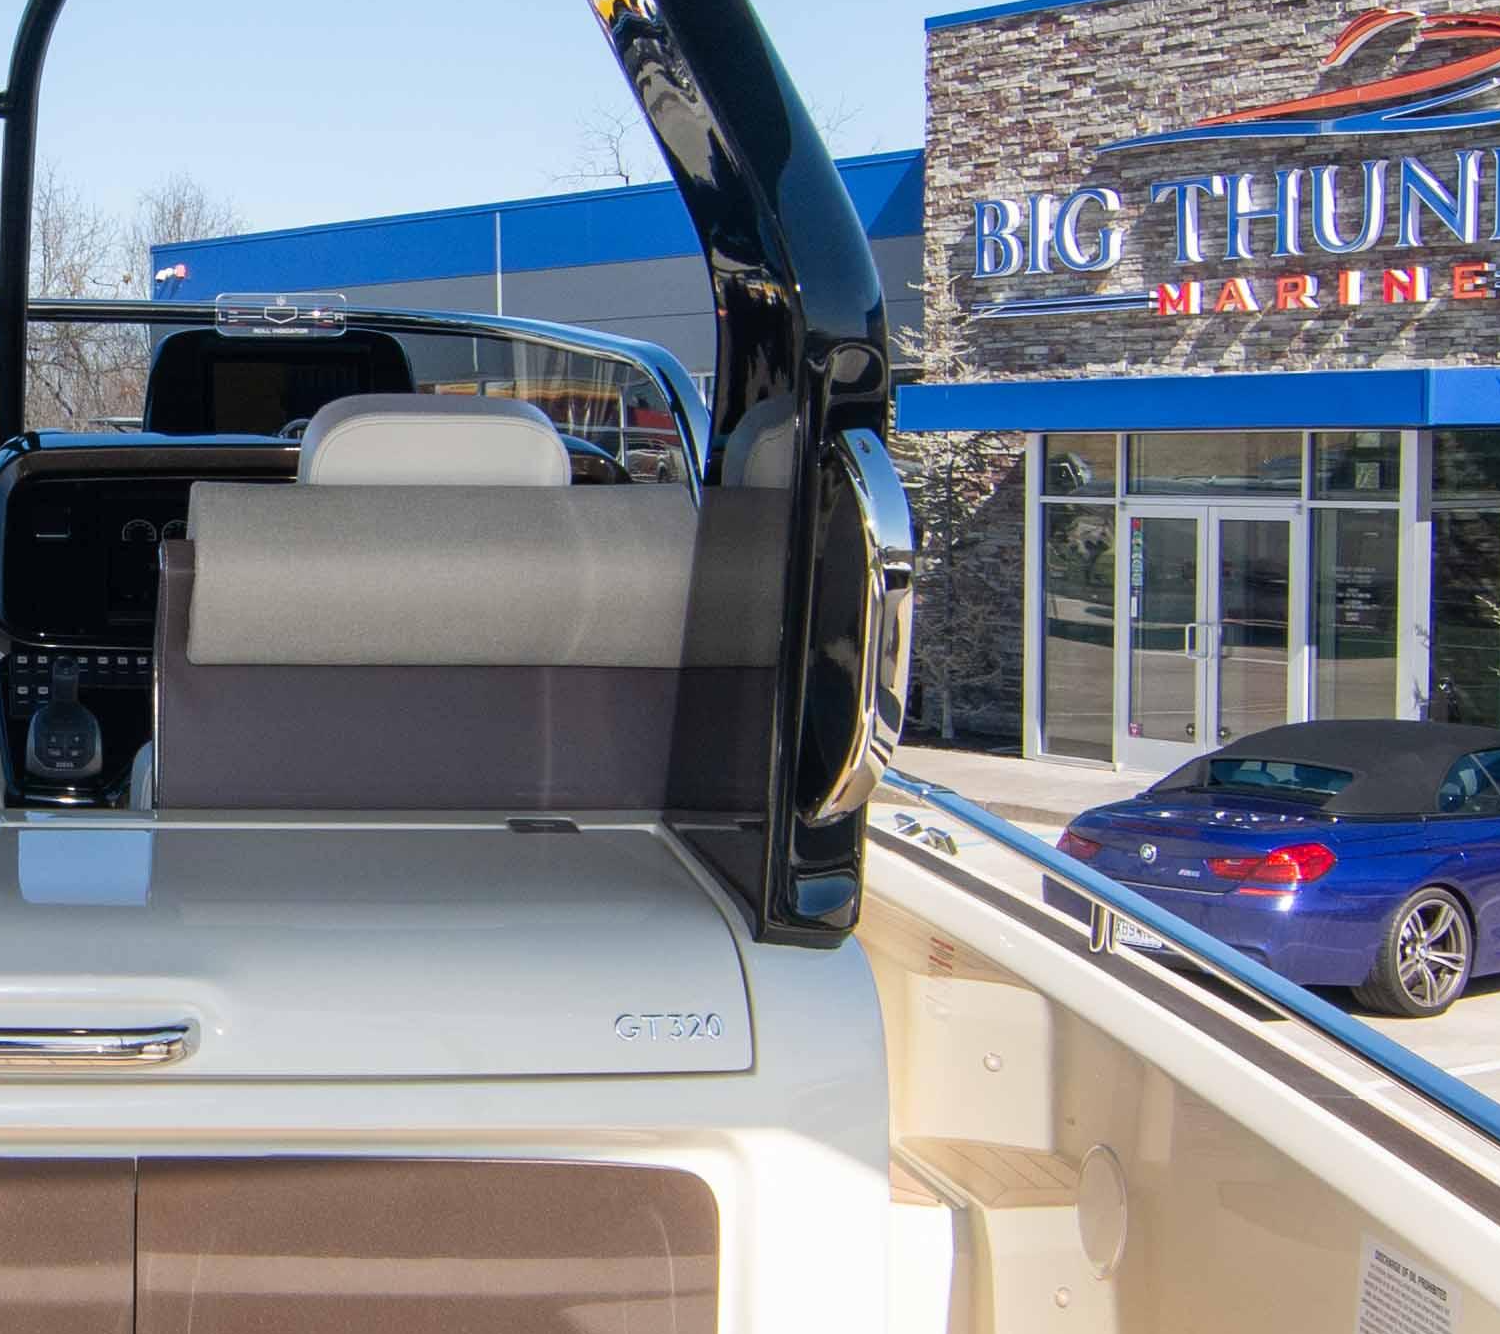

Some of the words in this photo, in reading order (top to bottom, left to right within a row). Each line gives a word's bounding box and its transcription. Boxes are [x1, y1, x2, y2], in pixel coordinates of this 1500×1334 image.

[972, 187, 1124, 279] BIG
[1156, 262, 1494, 316] MARINE
[614, 1013, 723, 1041] GT320
